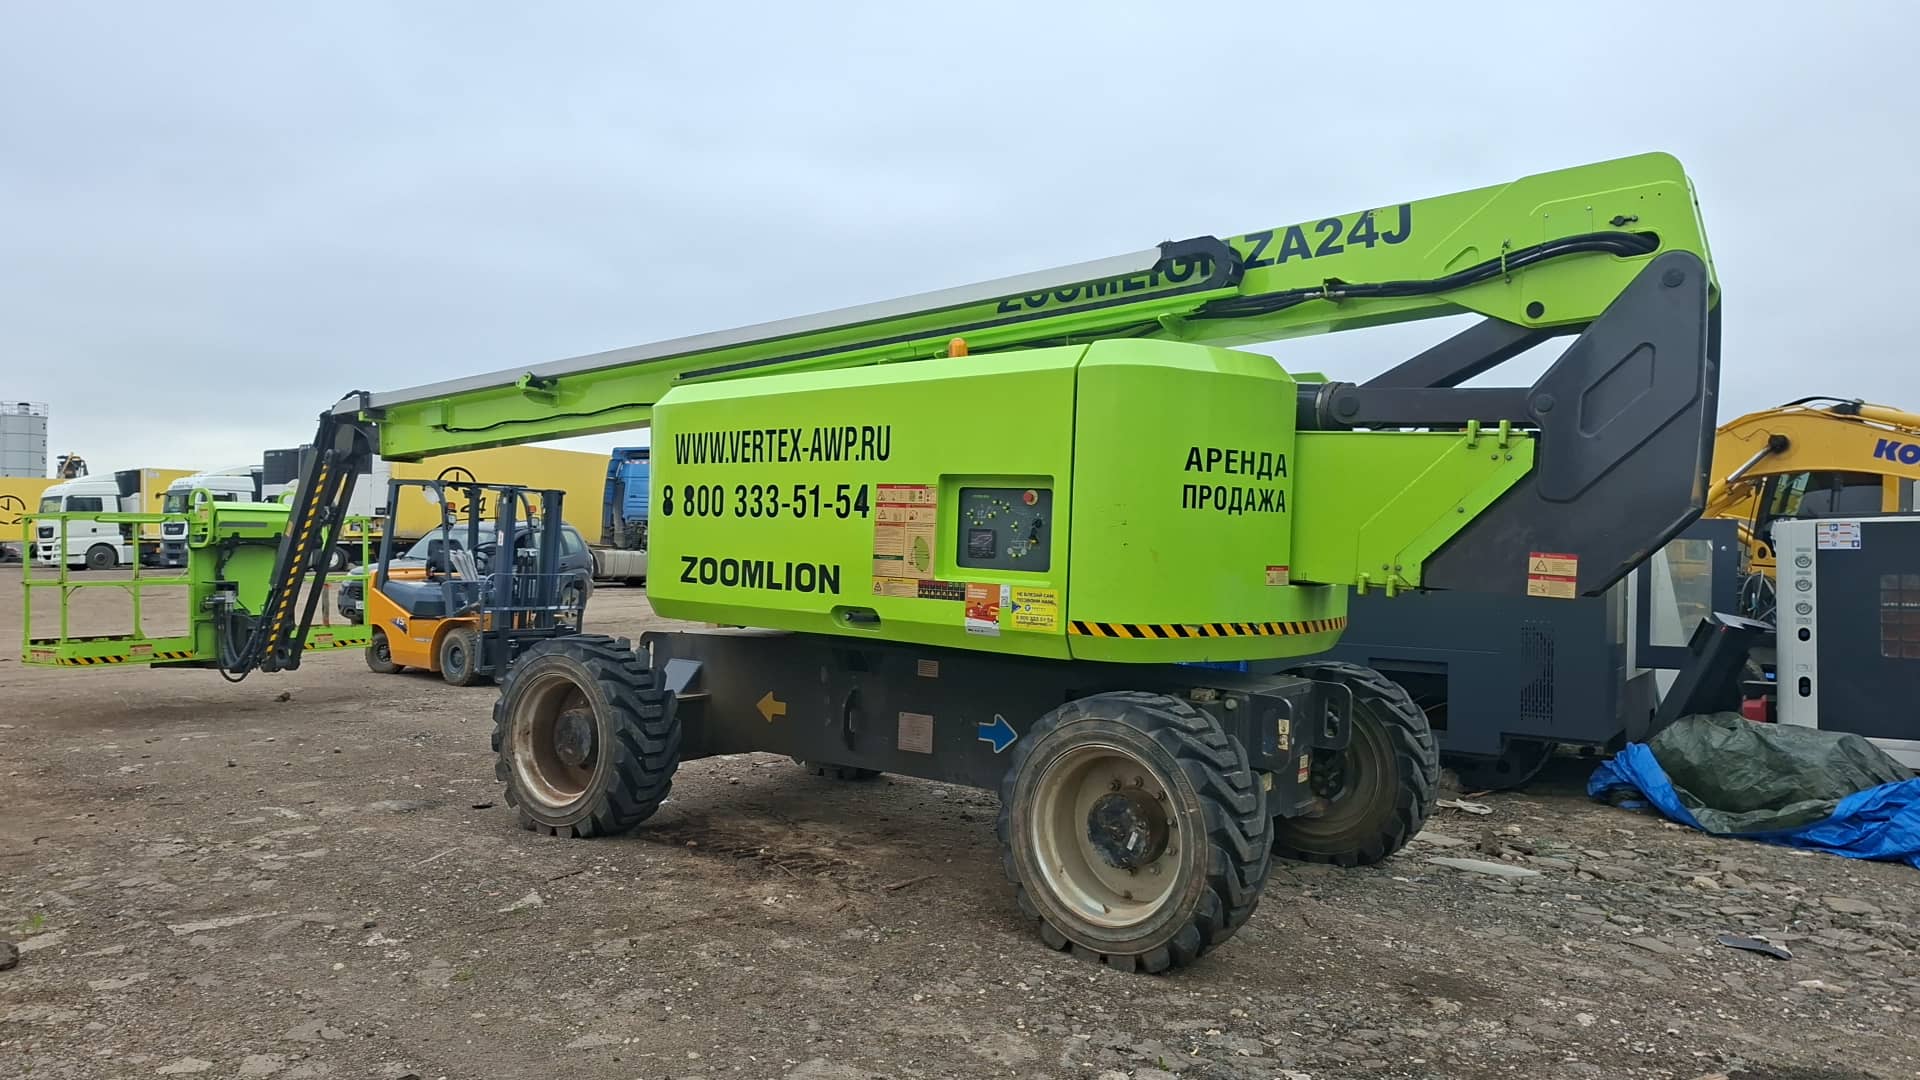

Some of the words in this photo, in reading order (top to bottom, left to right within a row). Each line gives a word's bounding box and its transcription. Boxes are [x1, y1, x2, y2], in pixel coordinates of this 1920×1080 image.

[1243, 203, 1412, 270] ZA24J
[675, 425, 891, 465] WWW.VERTEX-AWP.RU
[1873, 438, 1920, 465] KO
[1184, 447, 1287, 481] АРЕНДА
[662, 484, 674, 517] 8
[683, 484, 725, 518] 800
[734, 484, 870, 519] 333-51-54
[1182, 484, 1286, 516] ПРОДАЖА
[680, 556, 840, 595] ZOOMLION
